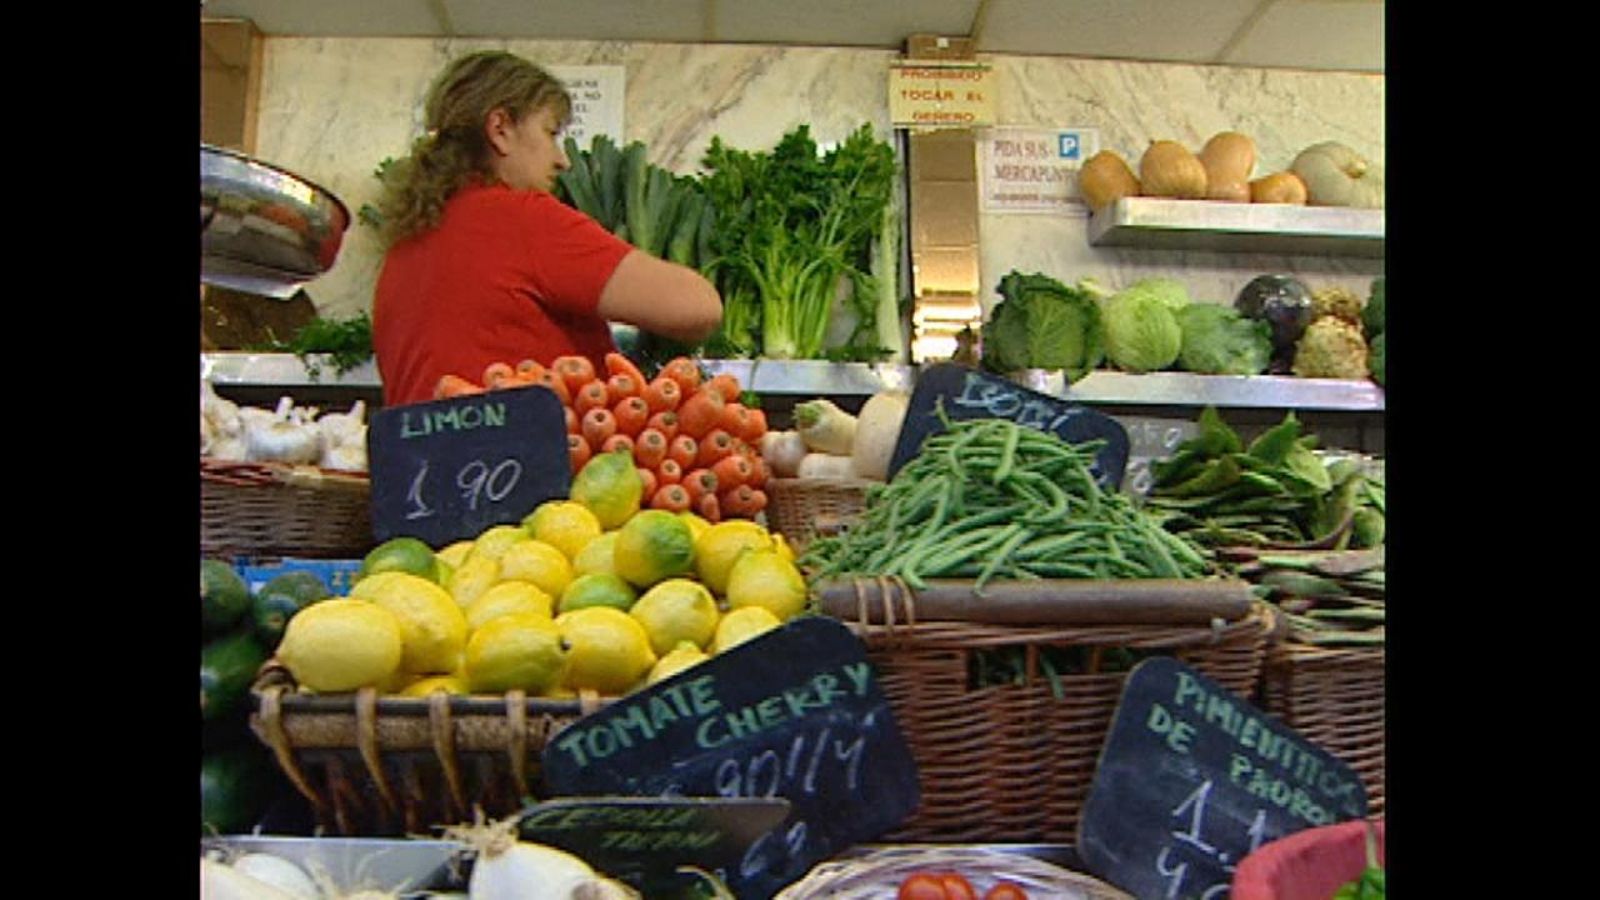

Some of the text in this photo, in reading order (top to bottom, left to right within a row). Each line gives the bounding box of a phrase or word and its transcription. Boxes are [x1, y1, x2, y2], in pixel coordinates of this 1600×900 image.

[901, 89, 955, 100] TOCAR
[401, 403, 505, 438] LIMON
[559, 674, 722, 767] TOMATE
[696, 662, 872, 748] CHERRY
[1147, 703, 1196, 753] DE
